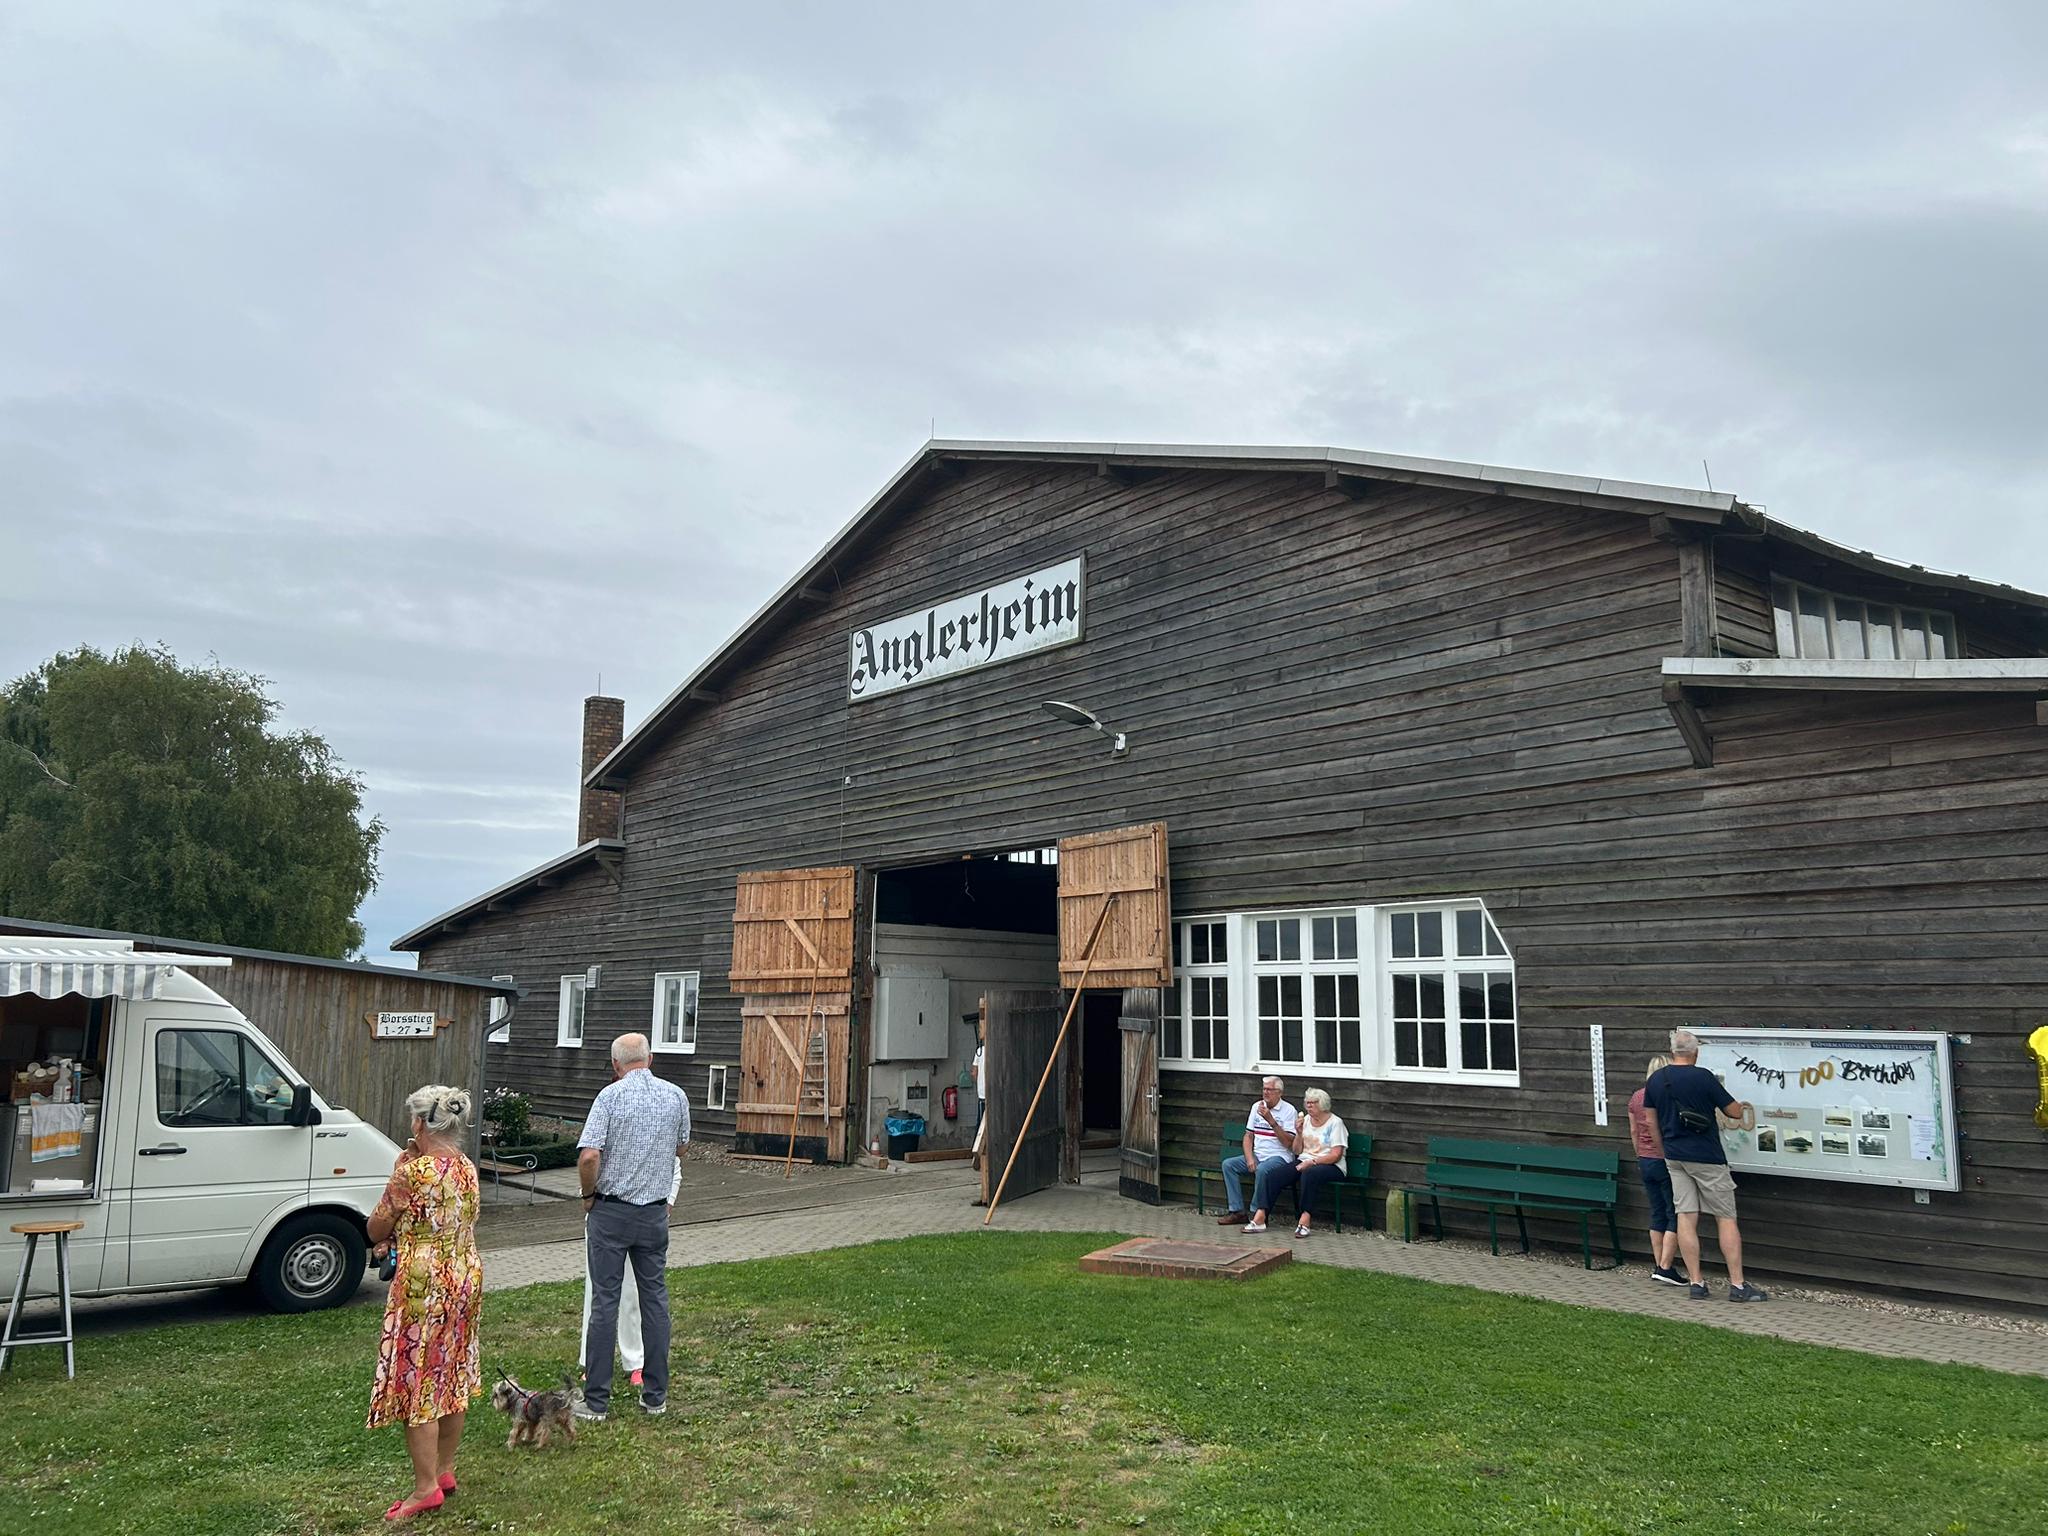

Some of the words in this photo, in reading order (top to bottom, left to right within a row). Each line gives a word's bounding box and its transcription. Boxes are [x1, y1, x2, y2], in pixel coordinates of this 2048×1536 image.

[851, 578, 1079, 695] Anglerheim
[1735, 1056, 1785, 1089] Happy
[1799, 1061, 1834, 1089] 100
[1841, 1060, 1915, 1085] Birthday
